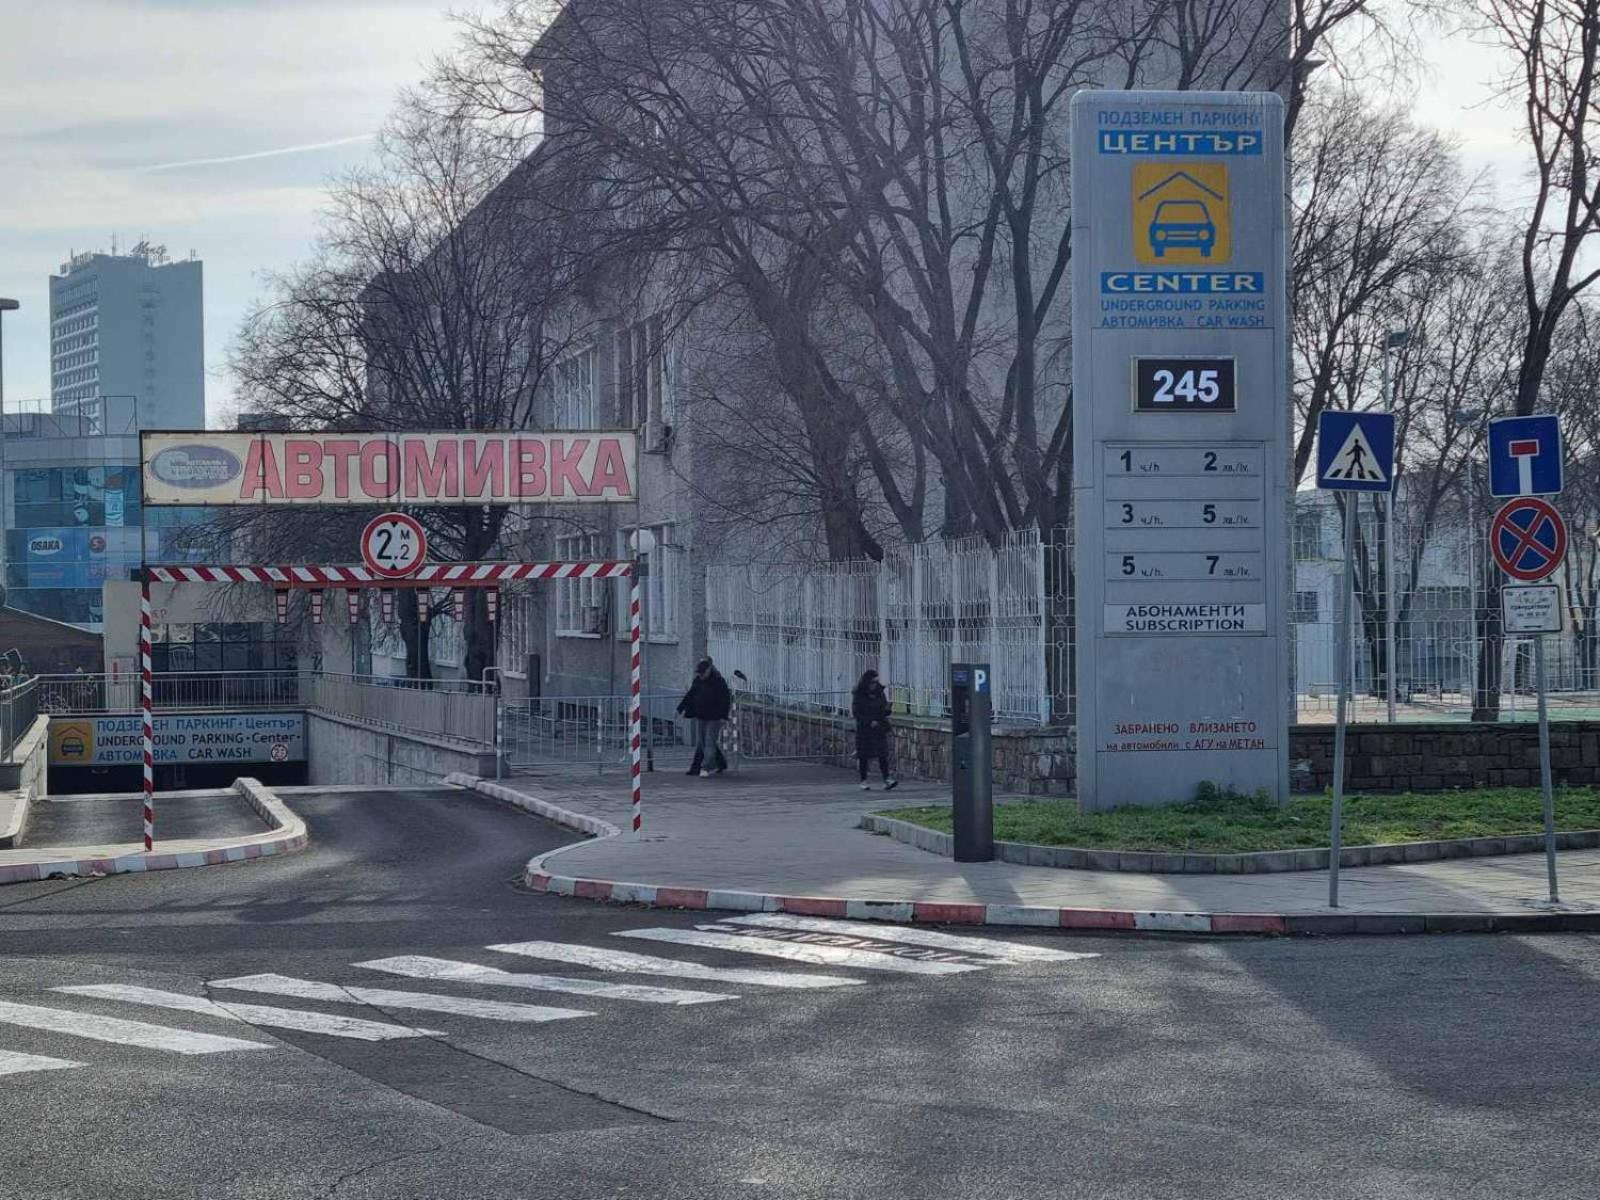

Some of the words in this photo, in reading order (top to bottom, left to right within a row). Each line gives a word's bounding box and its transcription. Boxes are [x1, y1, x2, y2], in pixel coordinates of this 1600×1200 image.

[1098, 111, 1183, 126] ПОДЗЕМЕН
[1104, 134, 1257, 153] ЦЕНТЪР
[1107, 274, 1257, 291] CENTER
[1101, 299, 1201, 311] UNDERGROUND
[1209, 299, 1265, 312] PARKING
[1102, 315, 1184, 327] АВТОМИВКА
[1197, 315, 1222, 327] CAR
[1229, 315, 1264, 327] WASH
[1153, 370, 1219, 402] 245
[240, 439, 632, 499] АВТОМИВКА
[1120, 450, 1132, 472] 1
[1203, 451, 1218, 471] 2
[1122, 503, 1134, 523] 3
[1203, 504, 1216, 523] 5
[31, 540, 60, 551] OSAKA
[1122, 555, 1136, 575] 5
[1206, 555, 1220, 575] 7
[1126, 606, 1245, 617] АБОНАМЕНТИ
[1126, 619, 1245, 631] SUBSCRIPTION
[974, 669, 986, 692] P
[97, 719, 169, 731] ПОДЗЕЕН
[176, 718, 236, 730] ПАРКИНГ
[1114, 722, 1180, 735] ЗАБРАНЕНО
[1189, 721, 1257, 734] ВЛИЗАНЕТО
[97, 735, 186, 747] UNDERGOUND
[192, 734, 244, 745] PARKING
[1121, 740, 1179, 750] автомобили
[1194, 739, 1213, 749] АГУ
[1229, 738, 1265, 749] МЕТАН
[97, 750, 177, 761] АВТОМВКА
[188, 748, 213, 759] CAR
[216, 747, 252, 758] WASH
